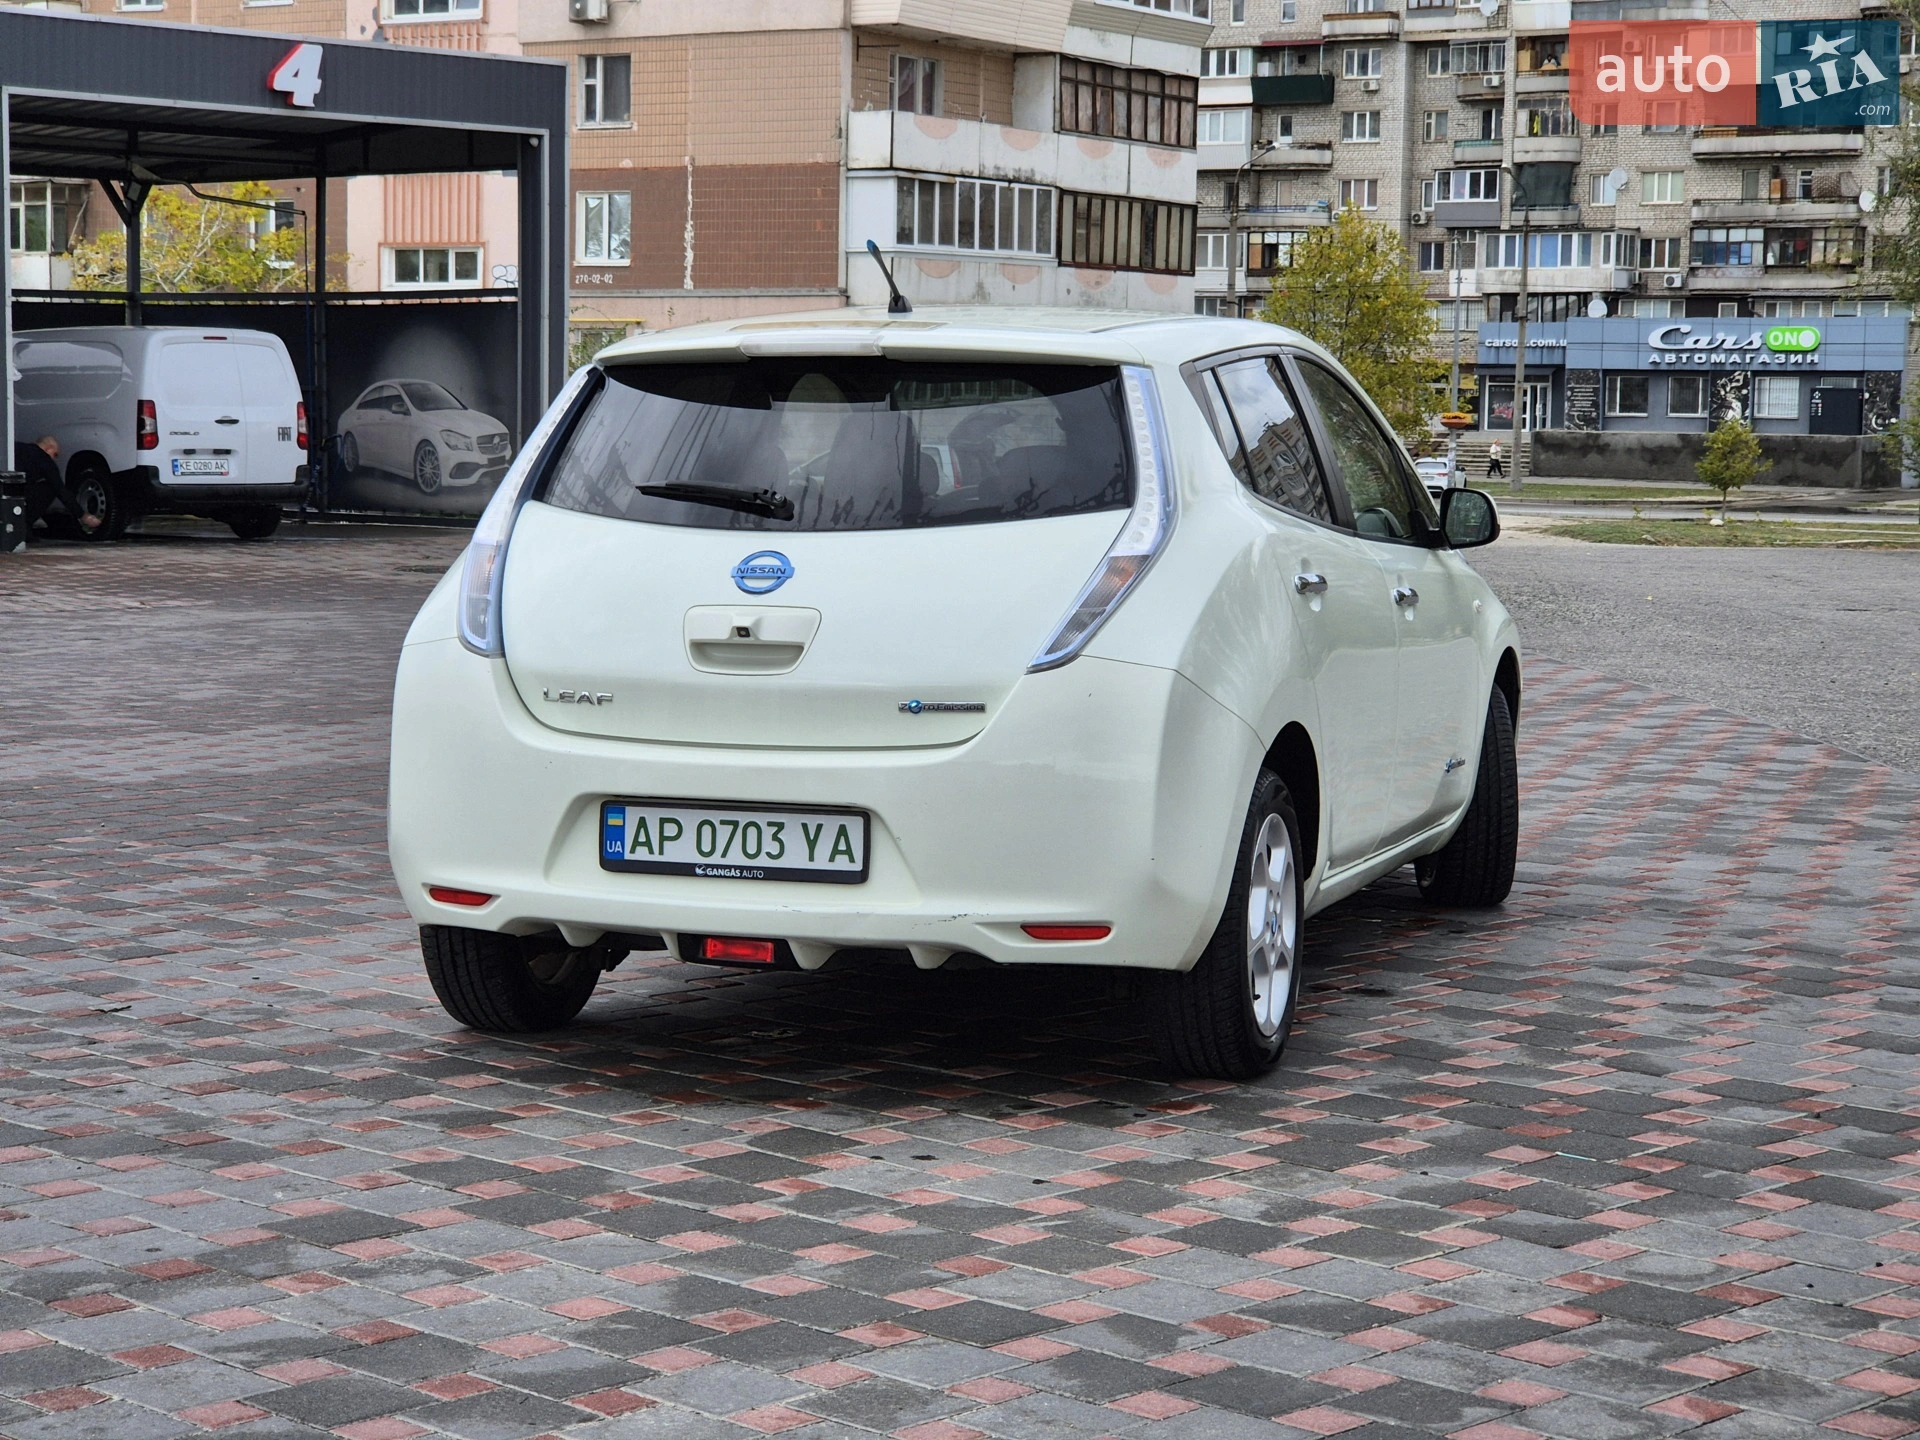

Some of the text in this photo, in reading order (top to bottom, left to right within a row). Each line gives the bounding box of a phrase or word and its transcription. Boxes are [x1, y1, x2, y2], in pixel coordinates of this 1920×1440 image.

[266, 42, 323, 107] 4
[575, 273, 614, 285] 270-02-02
[1647, 324, 1763, 350] Cars
[1647, 353, 1820, 365] АВТОМАГАЗИН
[277, 426, 292, 442] FIAT
[179, 461, 227, 471] KE 0280 AK
[736, 566, 787, 575] NISSAN
[543, 687, 614, 706] LEAF
[628, 815, 856, 864] AP 0703 YA
[606, 840, 623, 854] UA
[742, 869, 764, 879] AUTO
